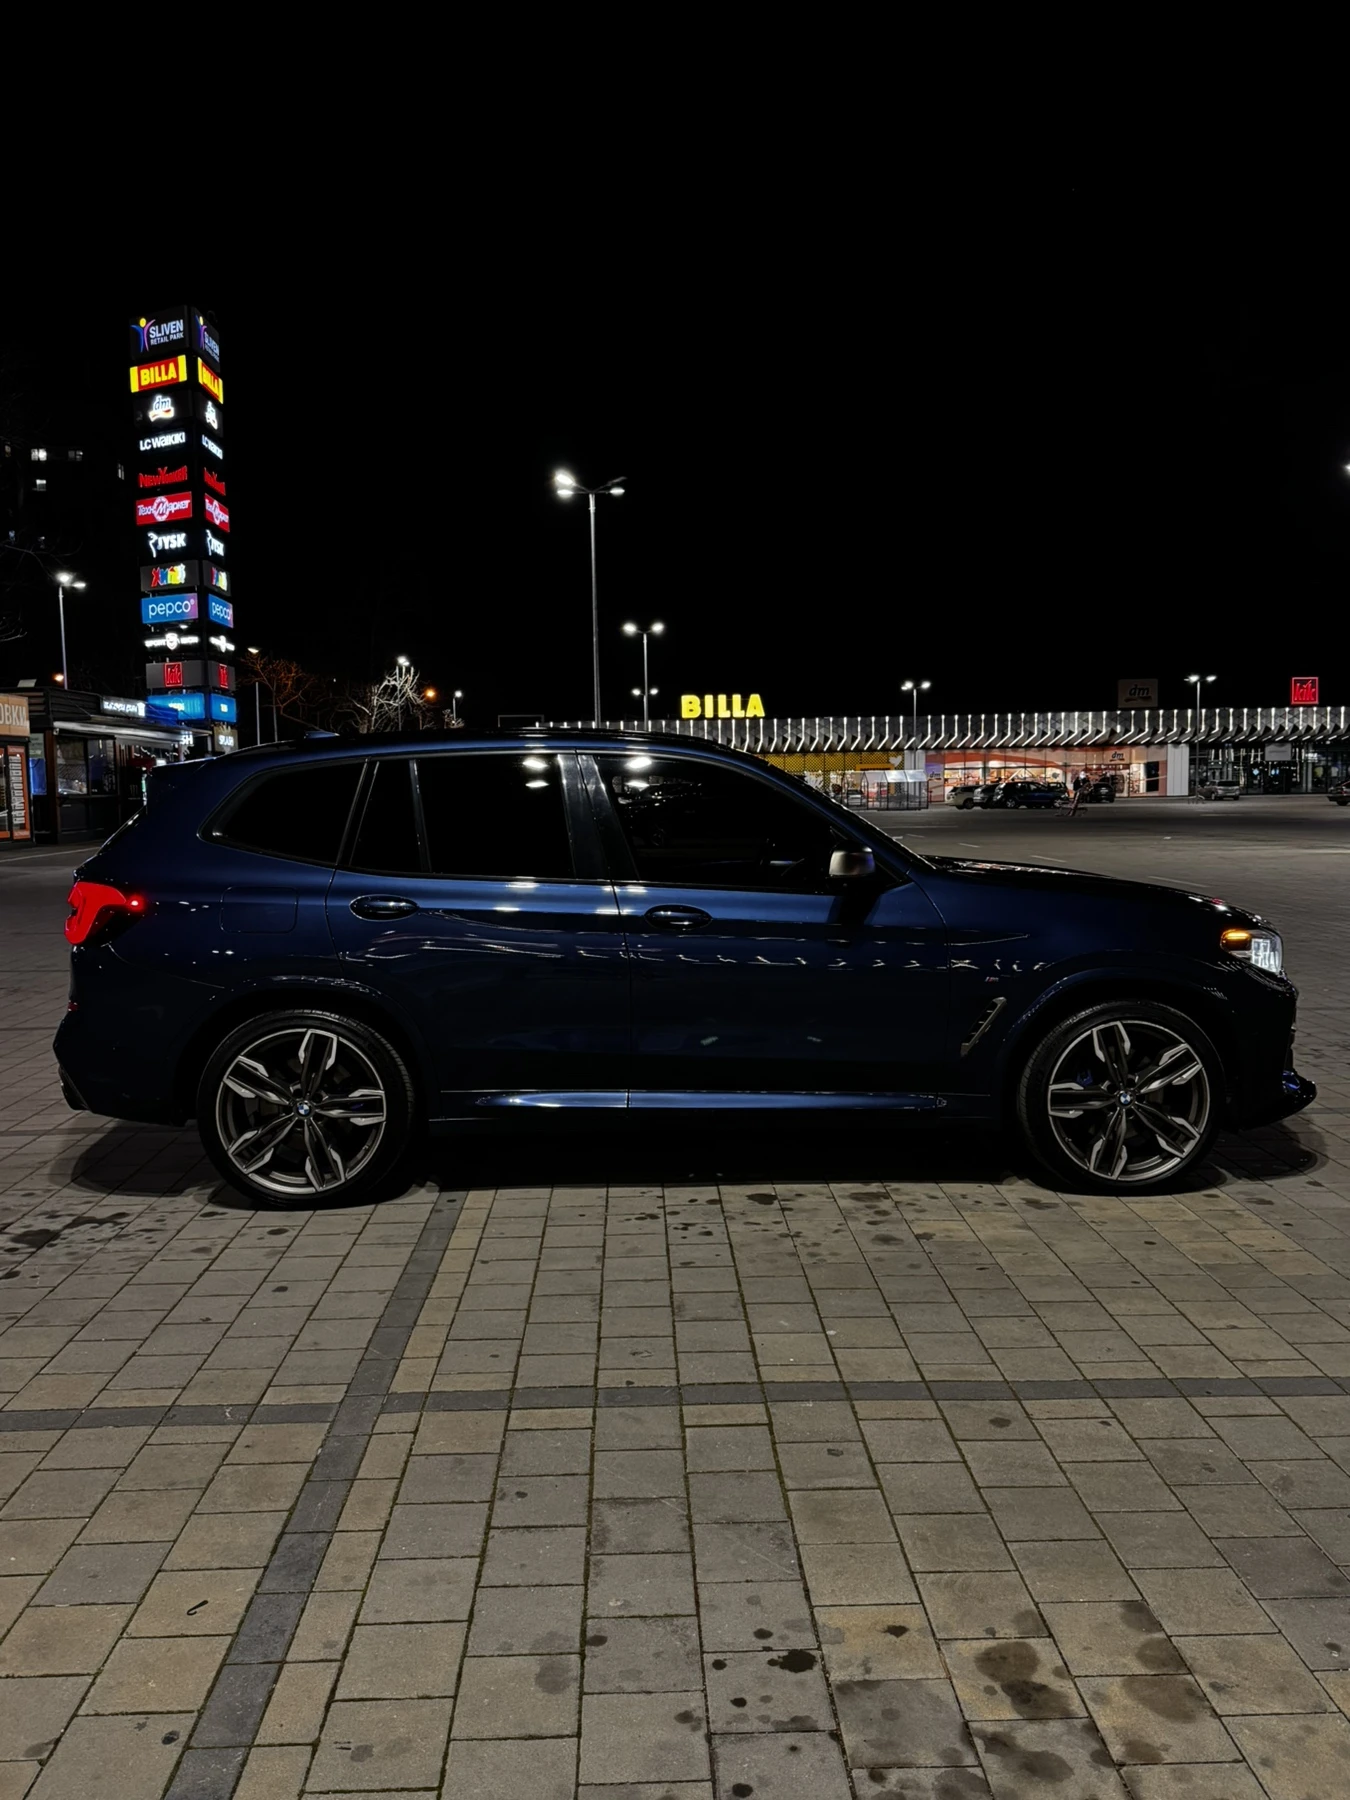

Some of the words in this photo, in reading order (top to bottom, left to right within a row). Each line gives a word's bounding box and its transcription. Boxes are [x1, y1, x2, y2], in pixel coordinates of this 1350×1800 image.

[149, 319, 184, 339] SLIVEN
[150, 335, 169, 346] RETAIL
[169, 331, 184, 342] PARK
[140, 362, 177, 386] BILLA
[157, 532, 187, 550] JYSK
[148, 600, 191, 619] pepco
[212, 602, 231, 620] pepco
[1128, 684, 1150, 697] dm
[681, 693, 765, 718] BILLA
[1111, 751, 1124, 759] dm
